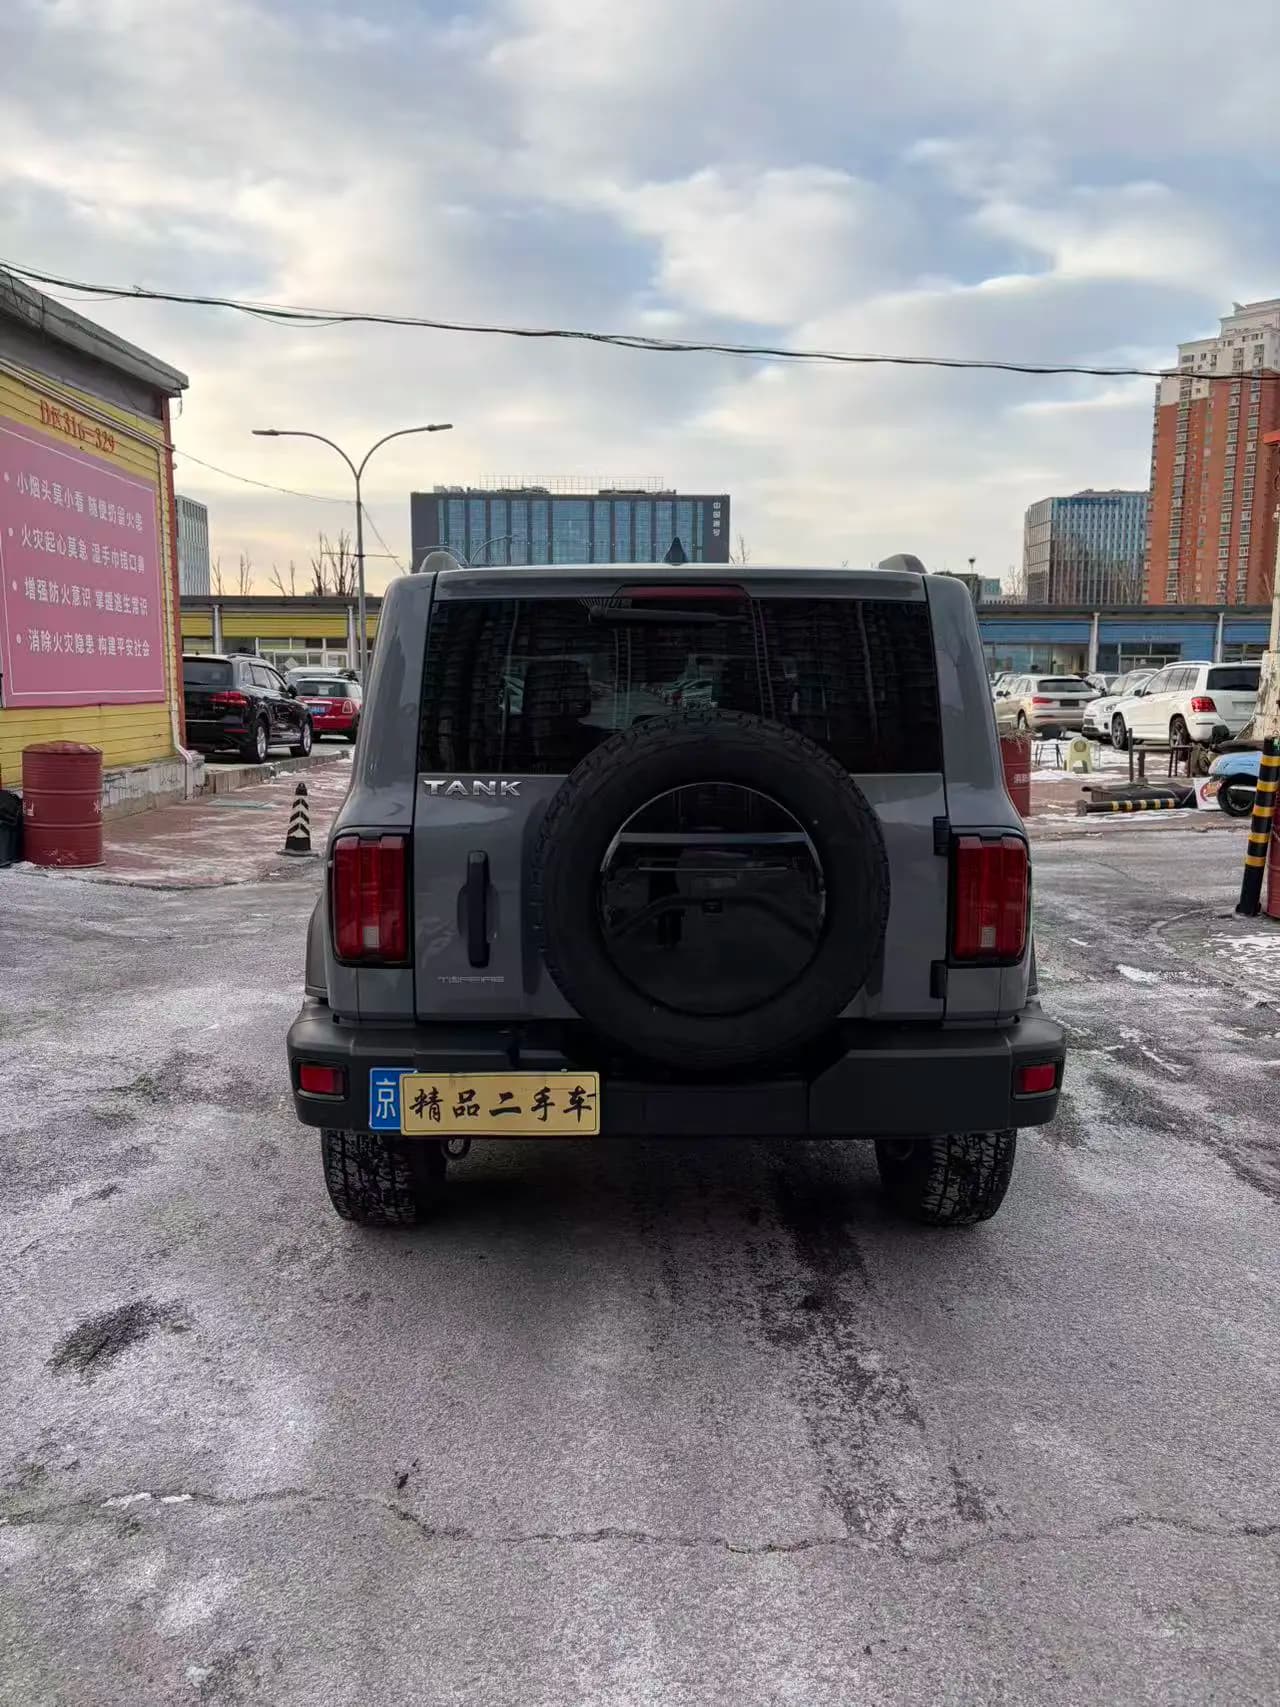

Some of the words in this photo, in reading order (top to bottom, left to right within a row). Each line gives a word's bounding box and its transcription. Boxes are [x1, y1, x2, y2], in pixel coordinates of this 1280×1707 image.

[17, 471, 84, 513] 小烟头莫小看
[21, 523, 88, 561] 火灾起心莫急
[92, 543, 145, 574] 湿手巾捂口鼻
[24, 576, 92, 608] 增强防火意识
[95, 591, 149, 616] 掌握逃生常识
[28, 628, 95, 654] 消除火灾隐患
[98, 635, 150, 657] 构建平安社会
[423, 780, 522, 796] TANK
[375, 1078, 397, 1120] 京
[409, 1086, 593, 1123] 精品二手车
